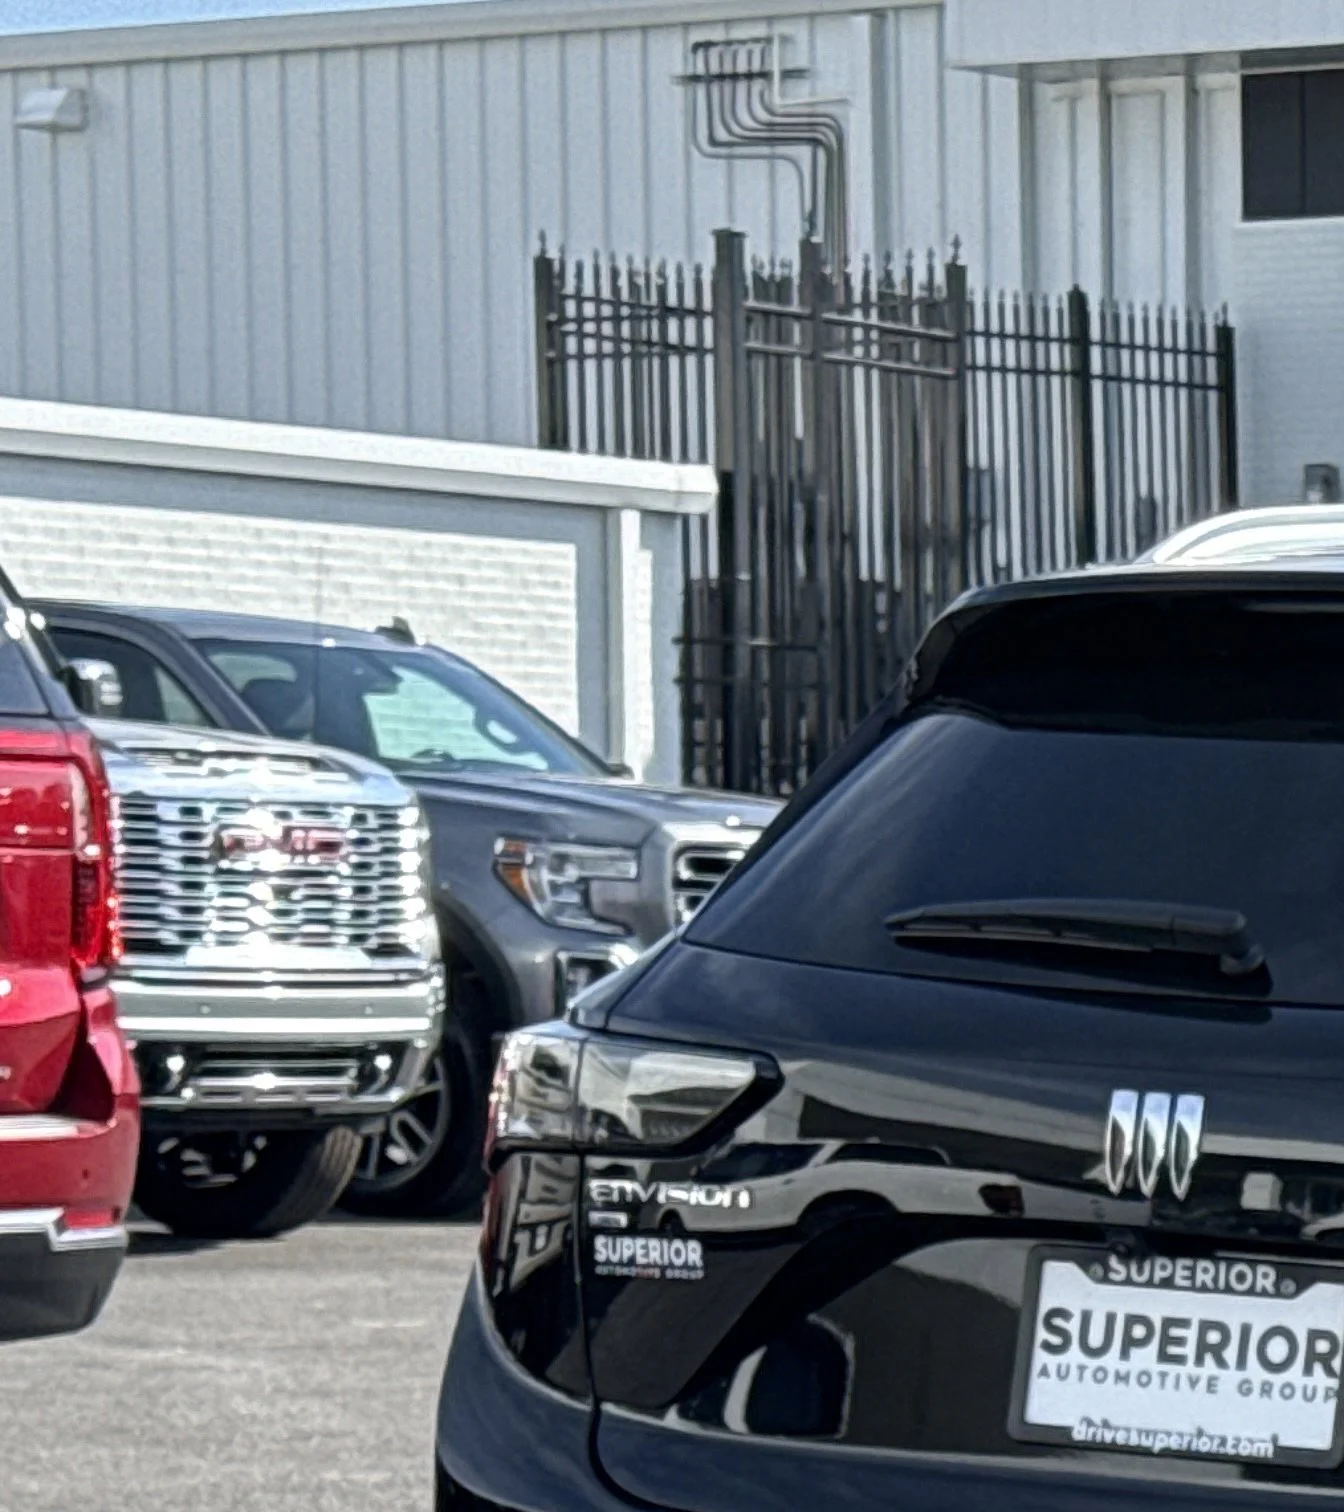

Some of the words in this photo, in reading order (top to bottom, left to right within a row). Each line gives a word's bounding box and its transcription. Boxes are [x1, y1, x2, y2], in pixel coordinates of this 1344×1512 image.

[594, 1235, 704, 1267] SUPERIOR
[1107, 1254, 1277, 1295] SUPERIOR
[1039, 1307, 1341, 1379] SUPERIOR
[1037, 1362, 1220, 1394] AUTOMOTIVE
[1237, 1378, 1339, 1404] GROUP
[1071, 1418, 1275, 1459] drivesuperior.com
